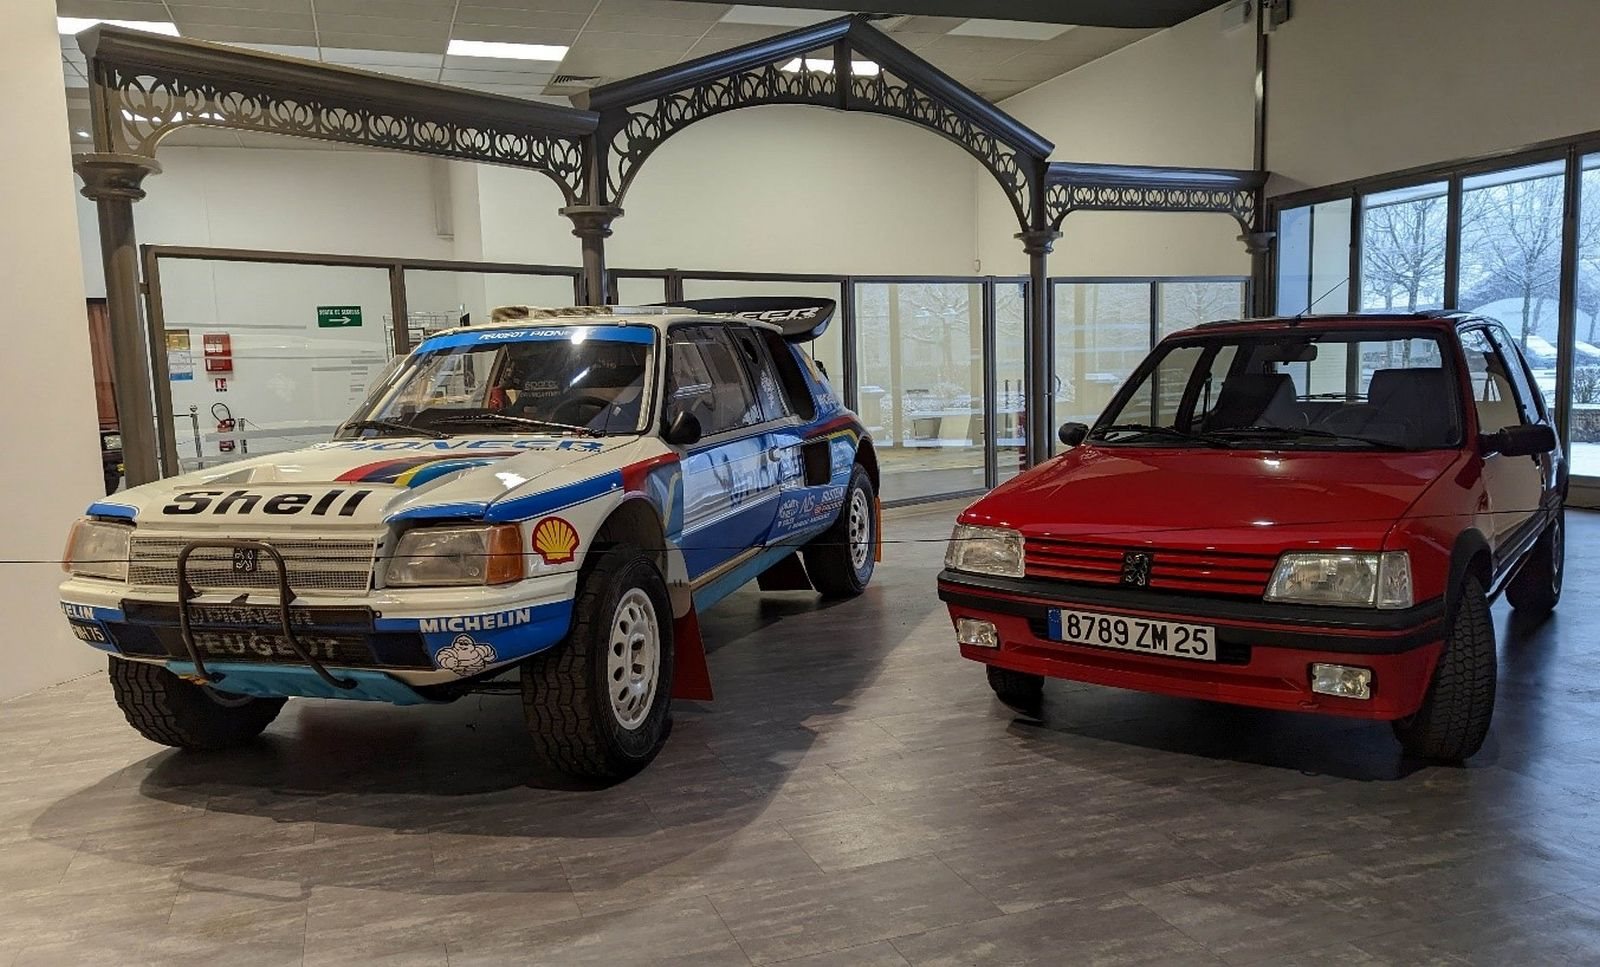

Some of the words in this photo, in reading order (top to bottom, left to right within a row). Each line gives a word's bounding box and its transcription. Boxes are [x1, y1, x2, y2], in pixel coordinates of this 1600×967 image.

[478, 331, 528, 340] PEUGEOT
[162, 490, 373, 516] Shell
[419, 608, 531, 634] MICHELIN
[1067, 613, 1129, 646] 8789
[1134, 621, 1168, 651] ZM
[1173, 626, 1208, 656] 25
